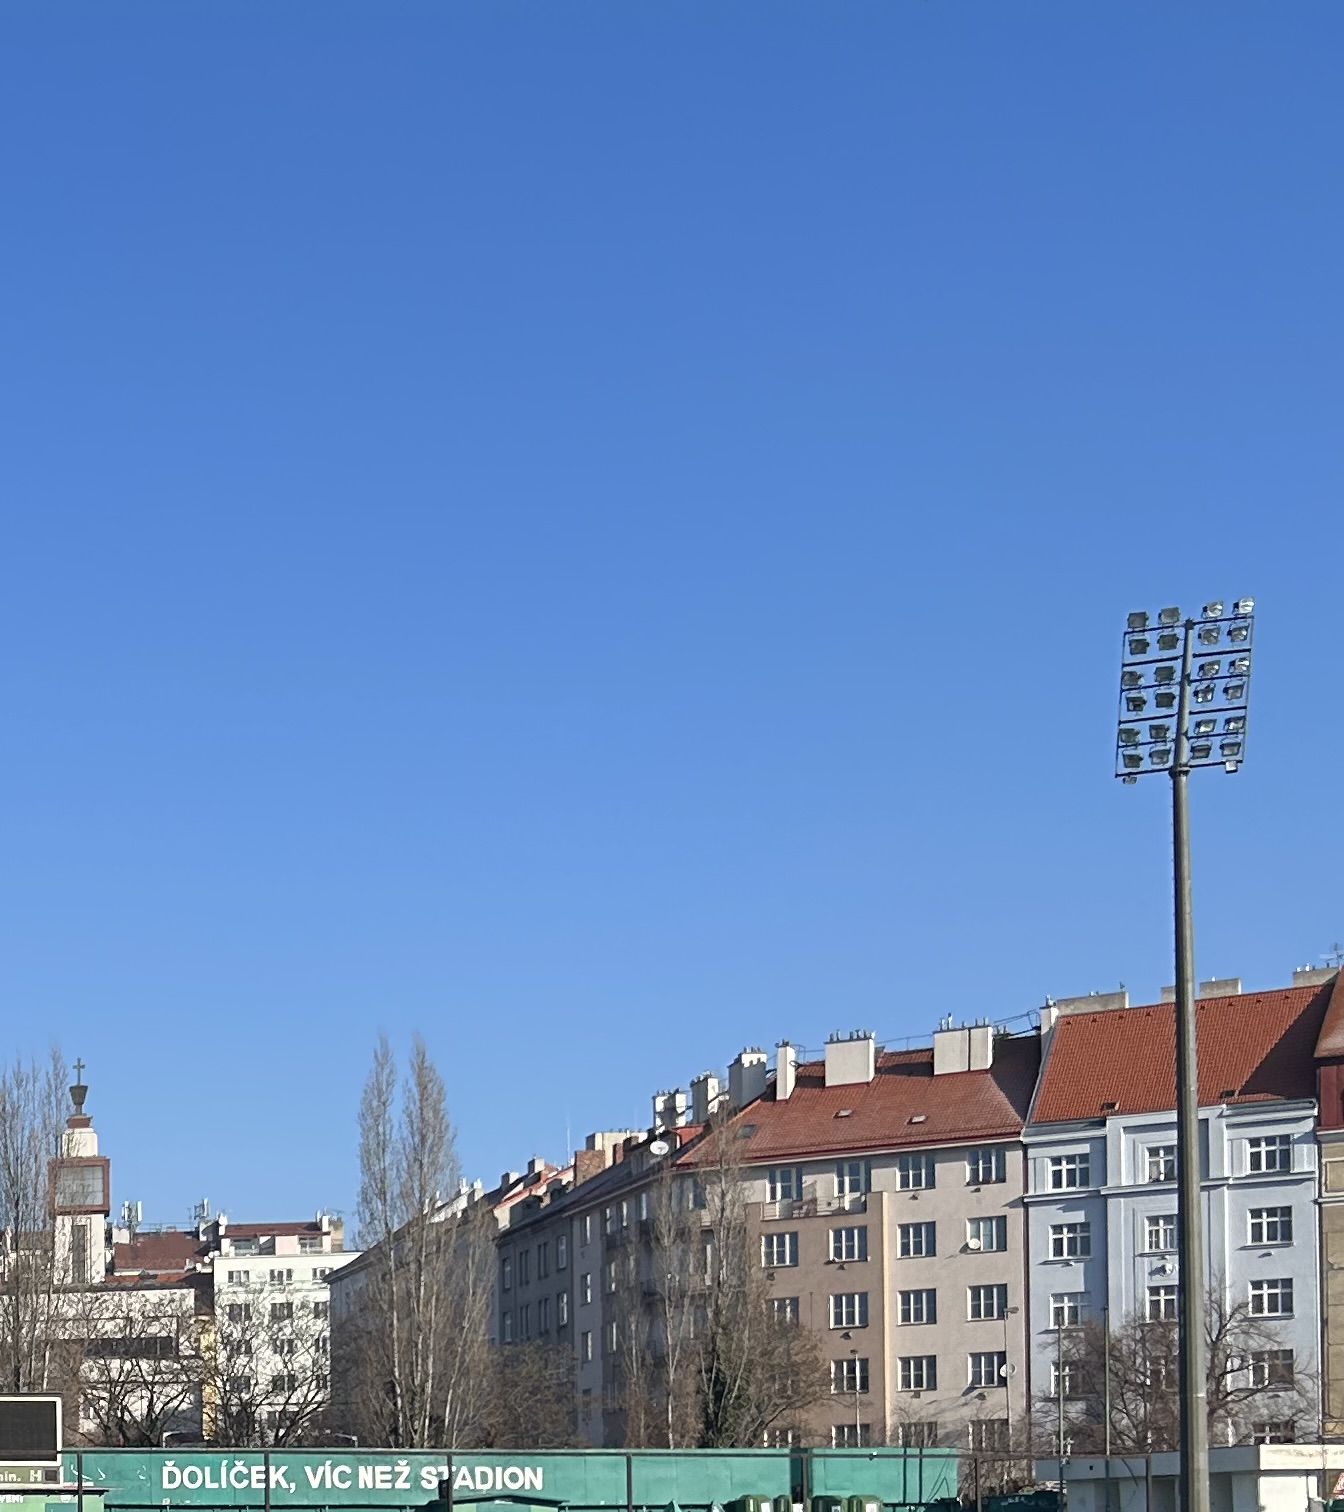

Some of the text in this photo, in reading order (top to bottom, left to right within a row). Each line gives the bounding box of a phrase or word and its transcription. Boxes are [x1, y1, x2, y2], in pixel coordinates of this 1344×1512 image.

[29, 1469, 42, 1482] H
[162, 1460, 296, 1493] ĎOLÍČEK,
[304, 1459, 352, 1490] VÍC
[358, 1459, 411, 1489] NEŽ
